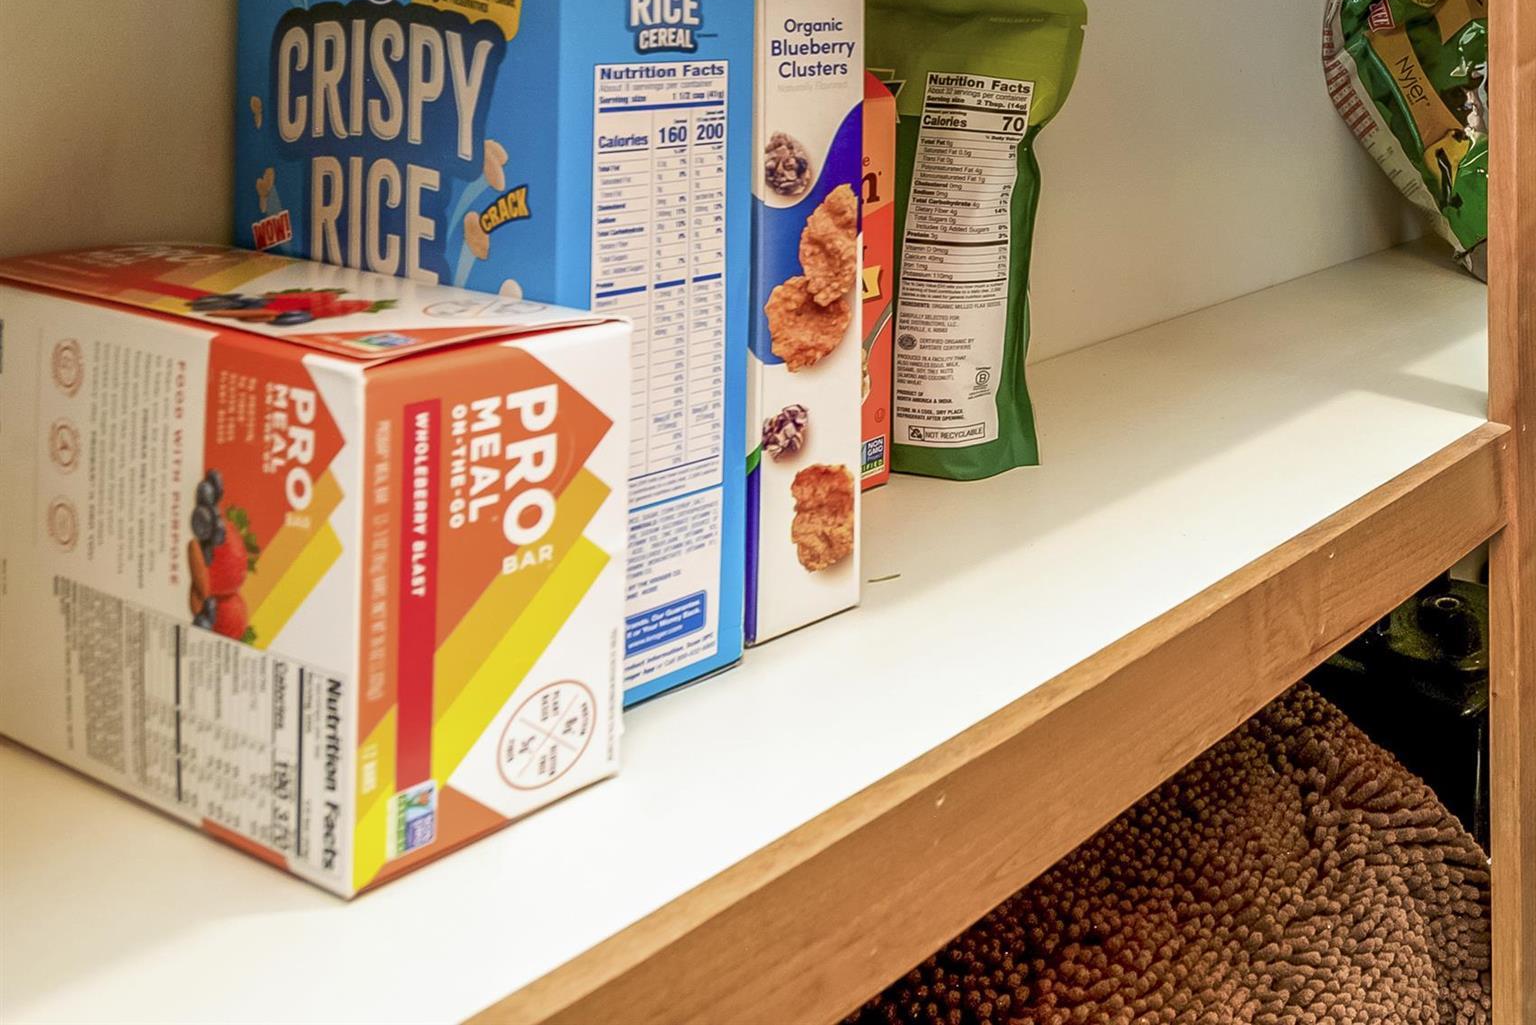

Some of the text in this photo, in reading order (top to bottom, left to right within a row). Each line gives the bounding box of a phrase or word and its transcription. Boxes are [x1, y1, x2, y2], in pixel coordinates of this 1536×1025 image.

[639, 28, 694, 50] CEREAL
[784, 18, 843, 37] Organic
[771, 40, 855, 57] Blueberry
[600, 63, 725, 80] Nutrition Facts
[778, 61, 848, 78] Clusters
[1395, 55, 1427, 106] Nyjer
[278, 18, 494, 161] CRISPY
[929, 74, 1030, 93] Nutrition Facts
[600, 94, 647, 104] Serving size
[926, 96, 950, 104] Serving
[996, 93, 1027, 101] container
[598, 123, 724, 149] Calories 160 200
[923, 115, 1025, 132] Calories 70
[481, 187, 530, 232] CRACK
[928, 199, 971, 207] Carbohydrate
[310, 156, 441, 285] RICE
[175, 360, 186, 419] FOOD
[271, 384, 288, 473] MEAL
[925, 426, 982, 439] NOT RECYCLABLE
[173, 428, 183, 483] WITH
[286, 387, 316, 511] PRO
[868, 439, 883, 449] NON
[868, 446, 883, 456] GMO
[449, 404, 468, 529] ON-THE-GO
[468, 396, 502, 523] MEAL
[503, 383, 559, 546] PRO
[411, 411, 430, 598] WHOLEBERRY BLAST
[502, 544, 554, 575] BAR
[321, 678, 342, 870] Nutrition Facts
